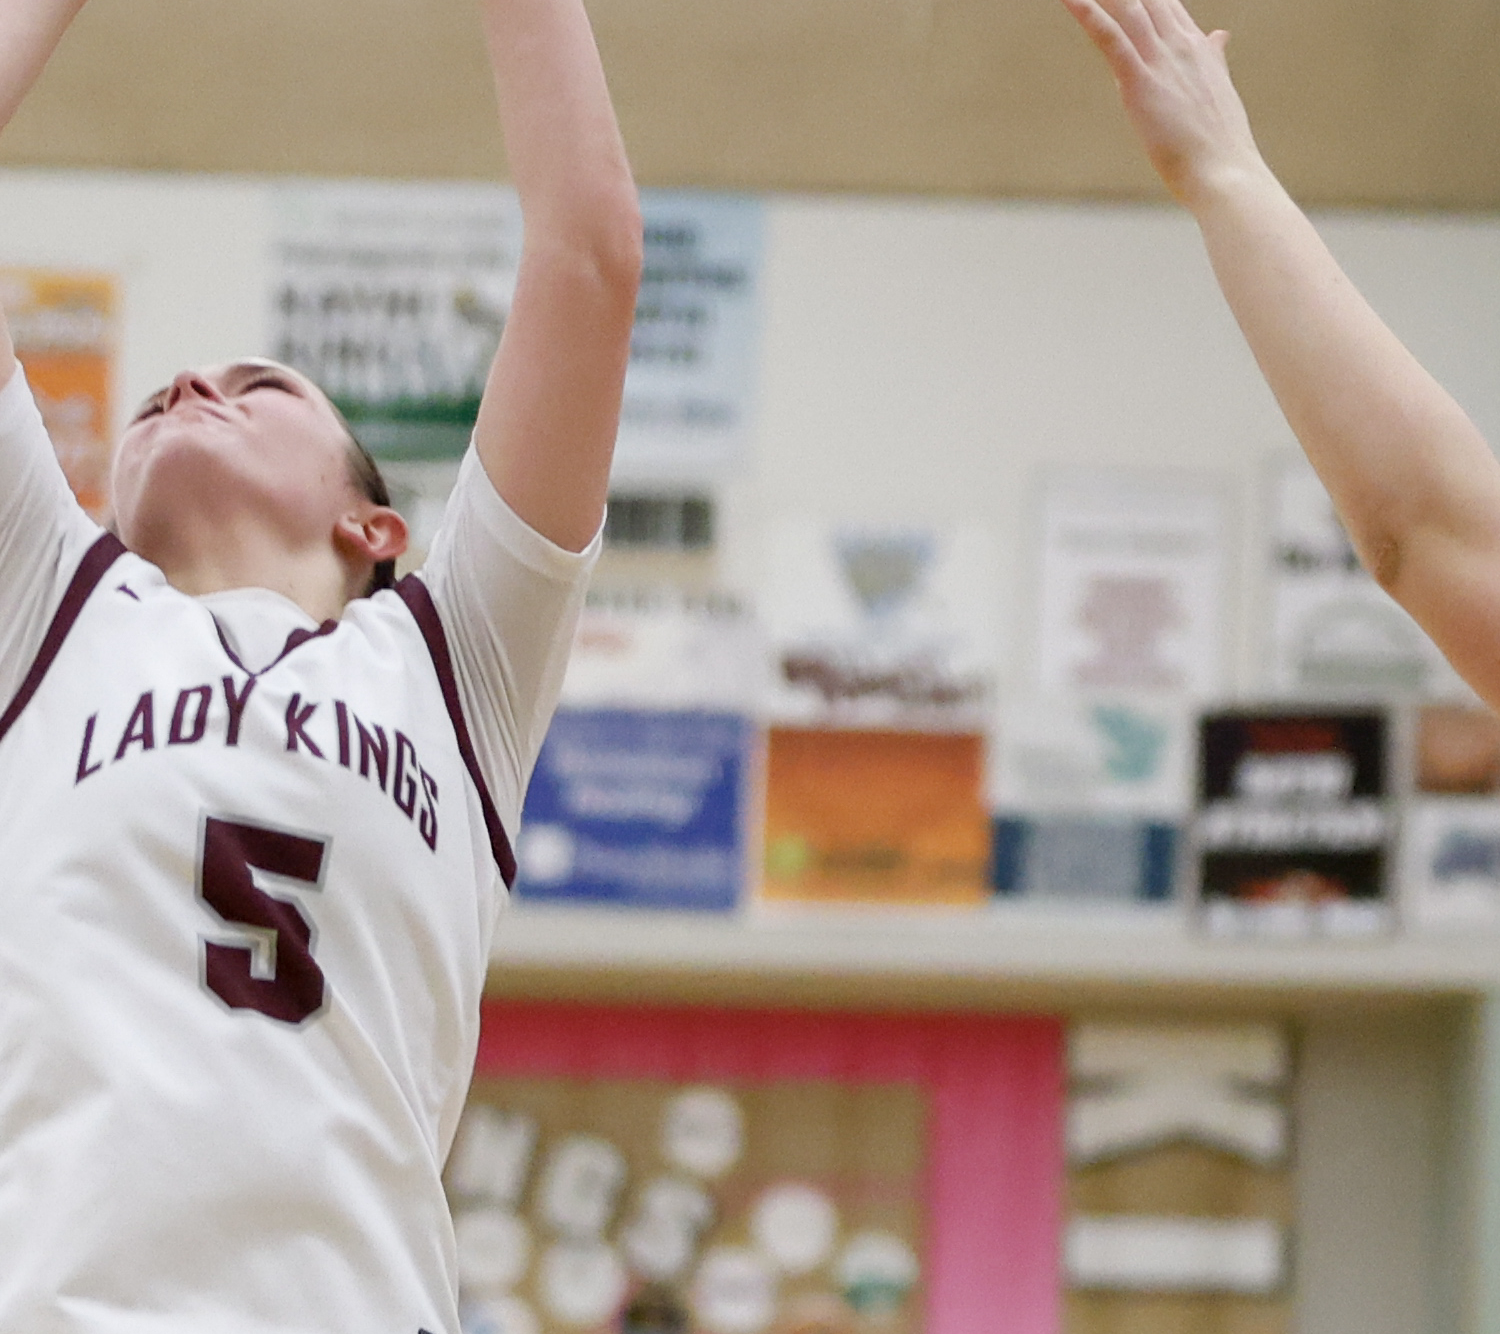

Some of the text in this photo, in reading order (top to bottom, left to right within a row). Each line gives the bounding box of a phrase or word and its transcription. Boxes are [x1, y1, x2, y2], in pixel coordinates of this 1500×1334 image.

[75, 674, 257, 787] LADY
[284, 696, 439, 855] KINGS
[197, 813, 334, 1033] 5
[450, 1103, 718, 1279] NGS
